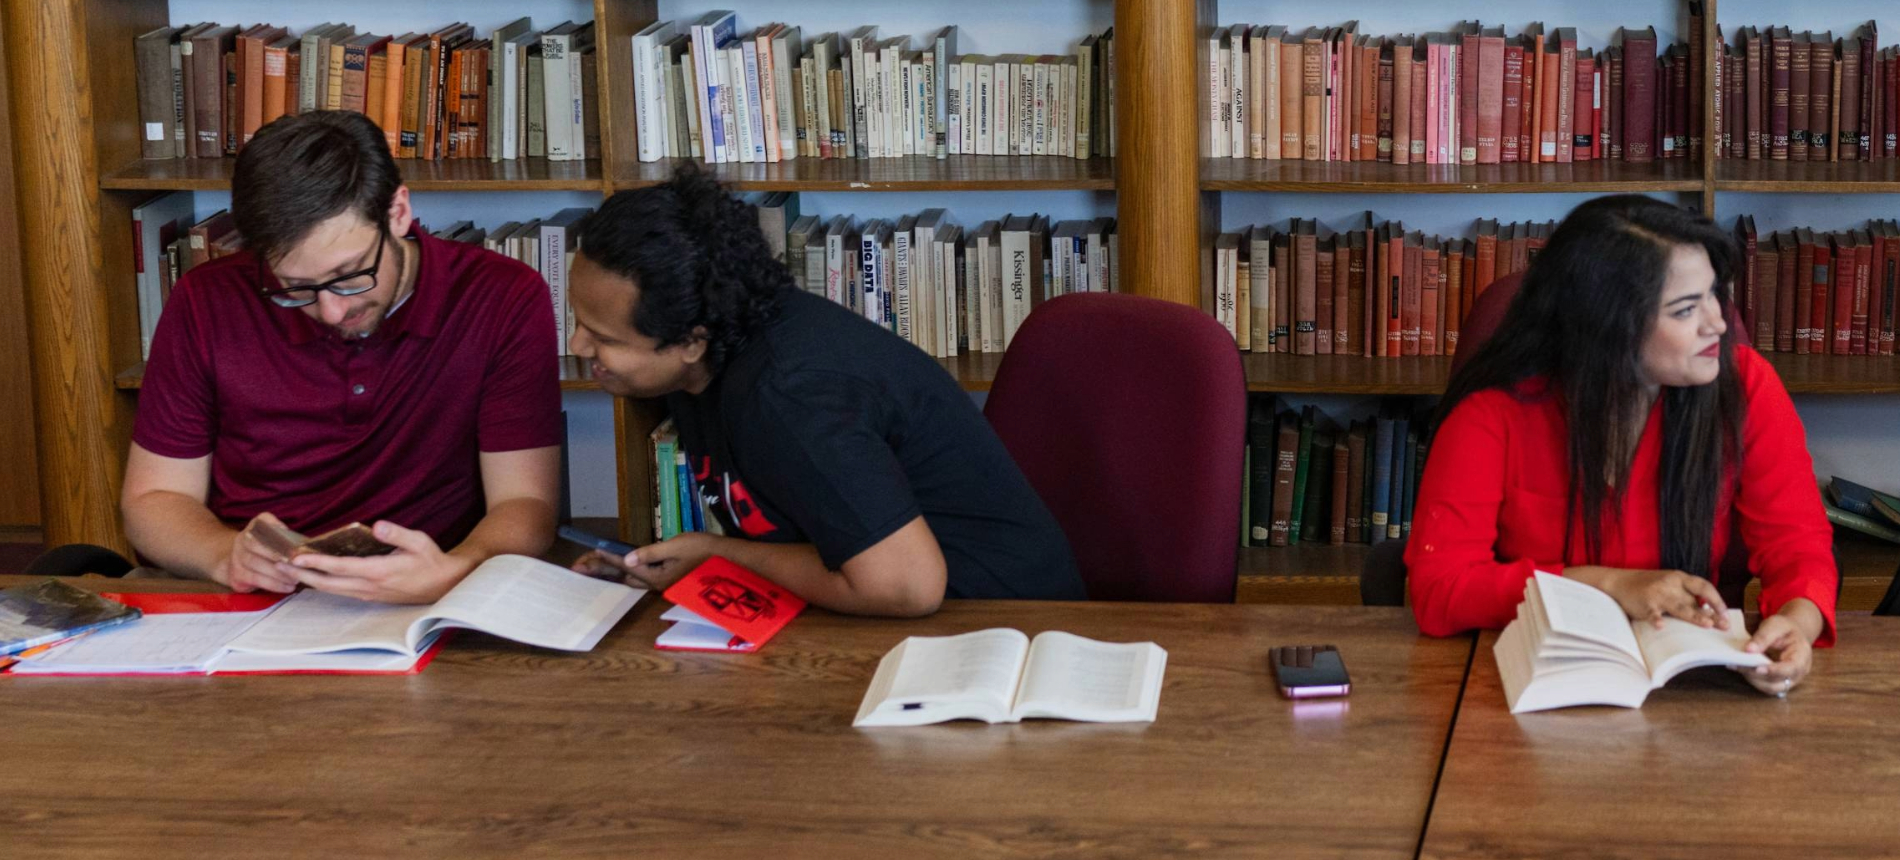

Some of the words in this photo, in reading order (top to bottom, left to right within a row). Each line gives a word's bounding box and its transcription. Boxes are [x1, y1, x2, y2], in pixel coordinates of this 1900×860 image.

[924, 64, 933, 95] American
[926, 96, 934, 135] Bureaucracy
[863, 240, 873, 261] BIG
[897, 236, 908, 262] GIANTS
[864, 264, 874, 293] DATA
[898, 266, 908, 291] DWARFS
[1011, 250, 1024, 302] Kissinger
[898, 293, 908, 316] ALLAN
[900, 317, 910, 339] BLOOM
